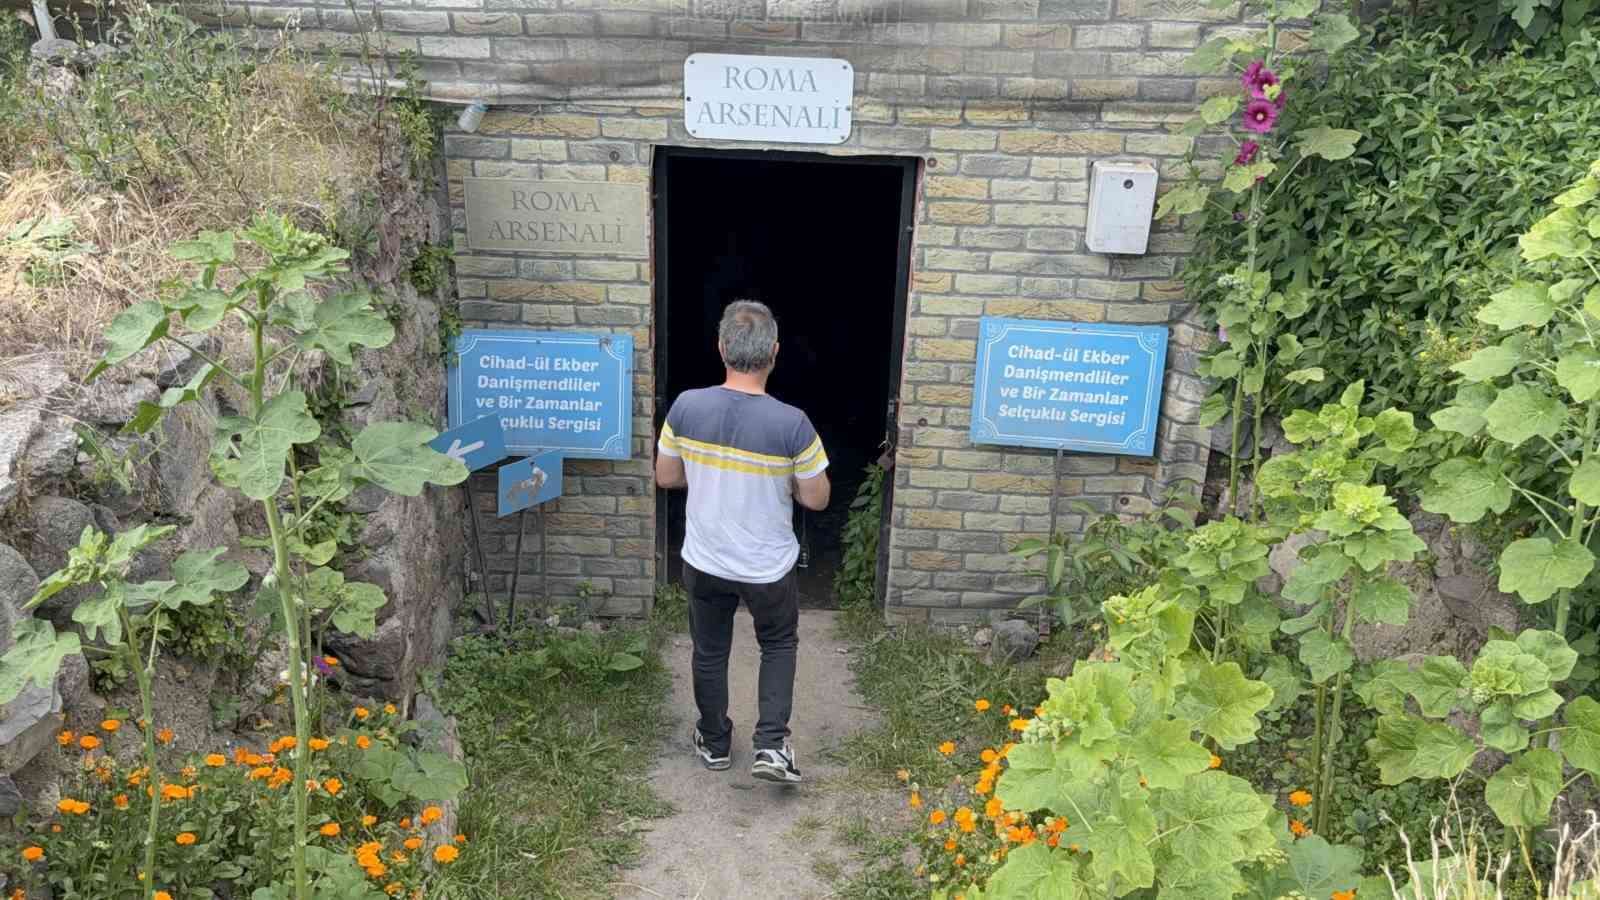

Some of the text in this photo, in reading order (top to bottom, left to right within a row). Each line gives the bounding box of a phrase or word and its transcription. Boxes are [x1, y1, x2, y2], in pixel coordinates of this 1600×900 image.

[722, 66, 819, 93] ROMA
[697, 99, 842, 129] ARSENALİ
[511, 190, 601, 213] ROMA
[487, 218, 625, 244] ARSENALİ
[479, 355, 599, 373] Cihad-ül Ekber
[1008, 344, 1130, 366] Cihad-ül Ekber
[477, 375, 601, 393] Danişmendliler
[1004, 364, 1129, 386] Danişmendliler
[475, 395, 603, 412] ve Bir Zamanlar
[1000, 385, 1129, 406] ve Bir Zamanlar
[477, 415, 601, 433] çuklu Sergisi
[999, 404, 1126, 427] Selçuklu Sergisi
